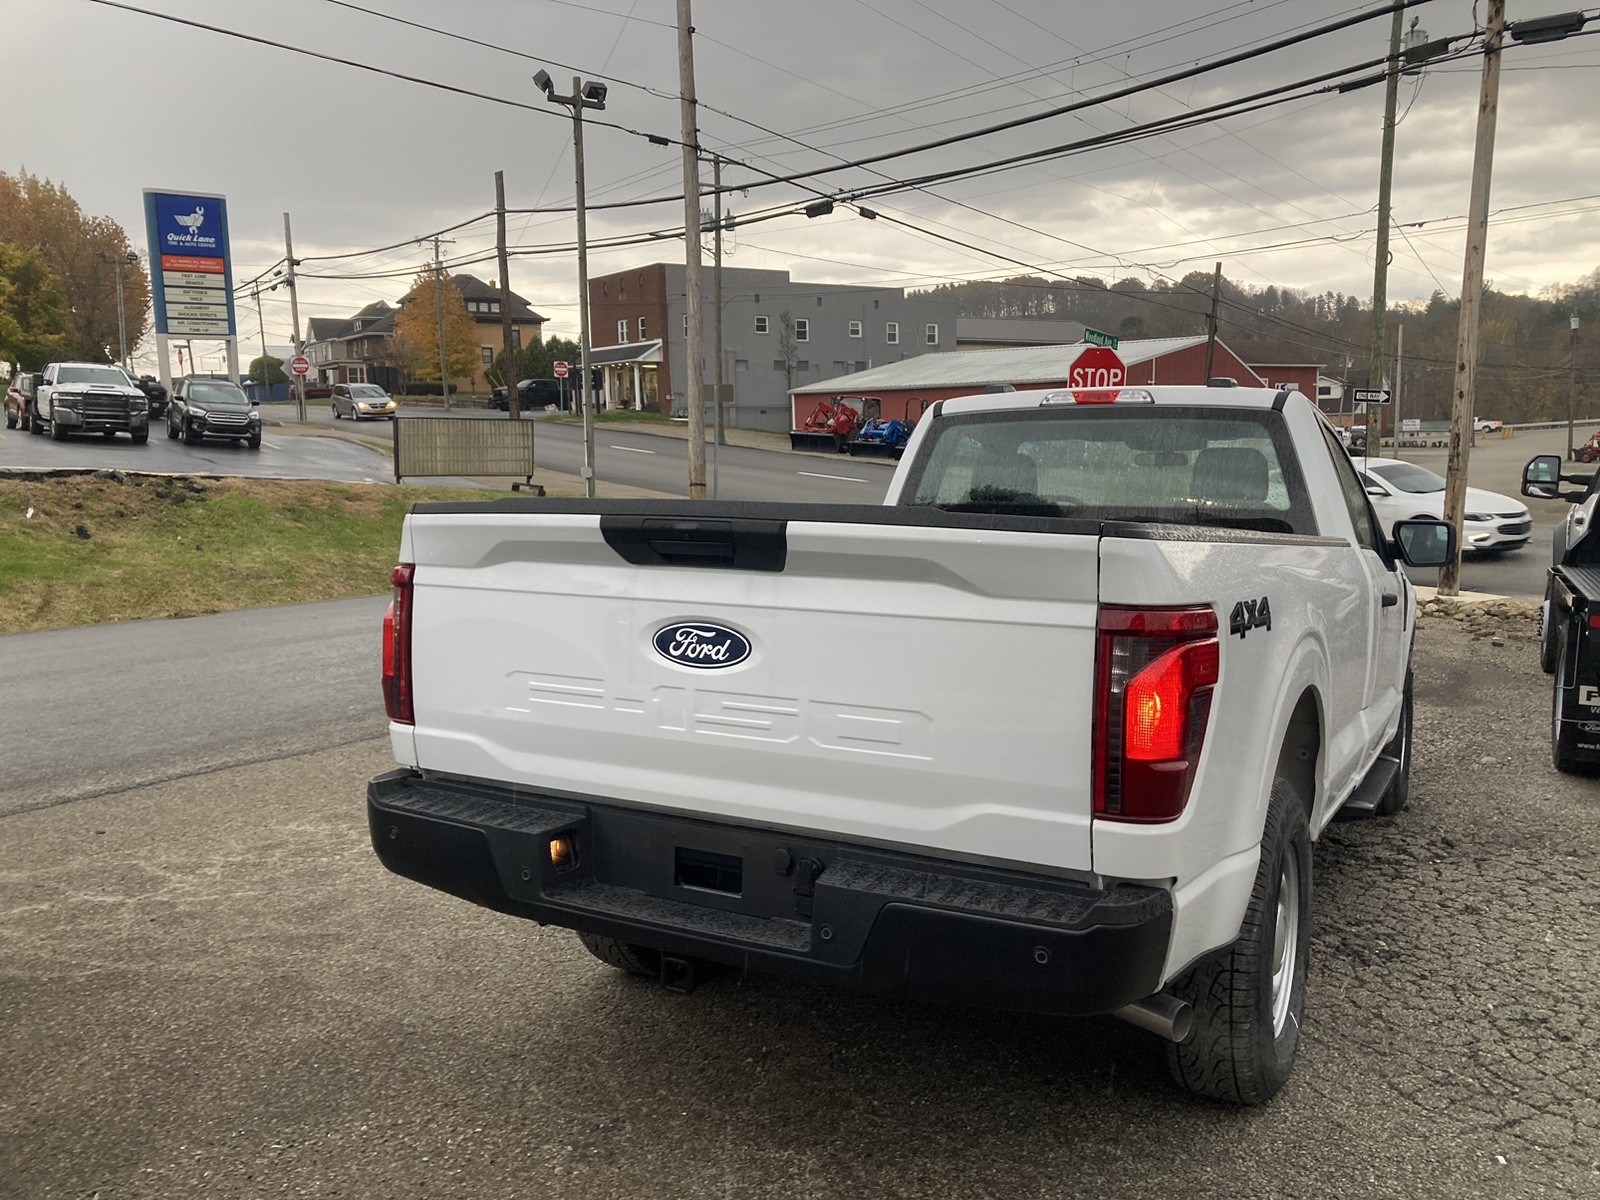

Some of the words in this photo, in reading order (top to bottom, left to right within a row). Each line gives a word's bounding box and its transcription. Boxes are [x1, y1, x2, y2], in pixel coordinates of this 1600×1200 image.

[167, 233, 193, 241] Quick
[1072, 368, 1122, 388] STOP
[669, 628, 731, 660] Ford
